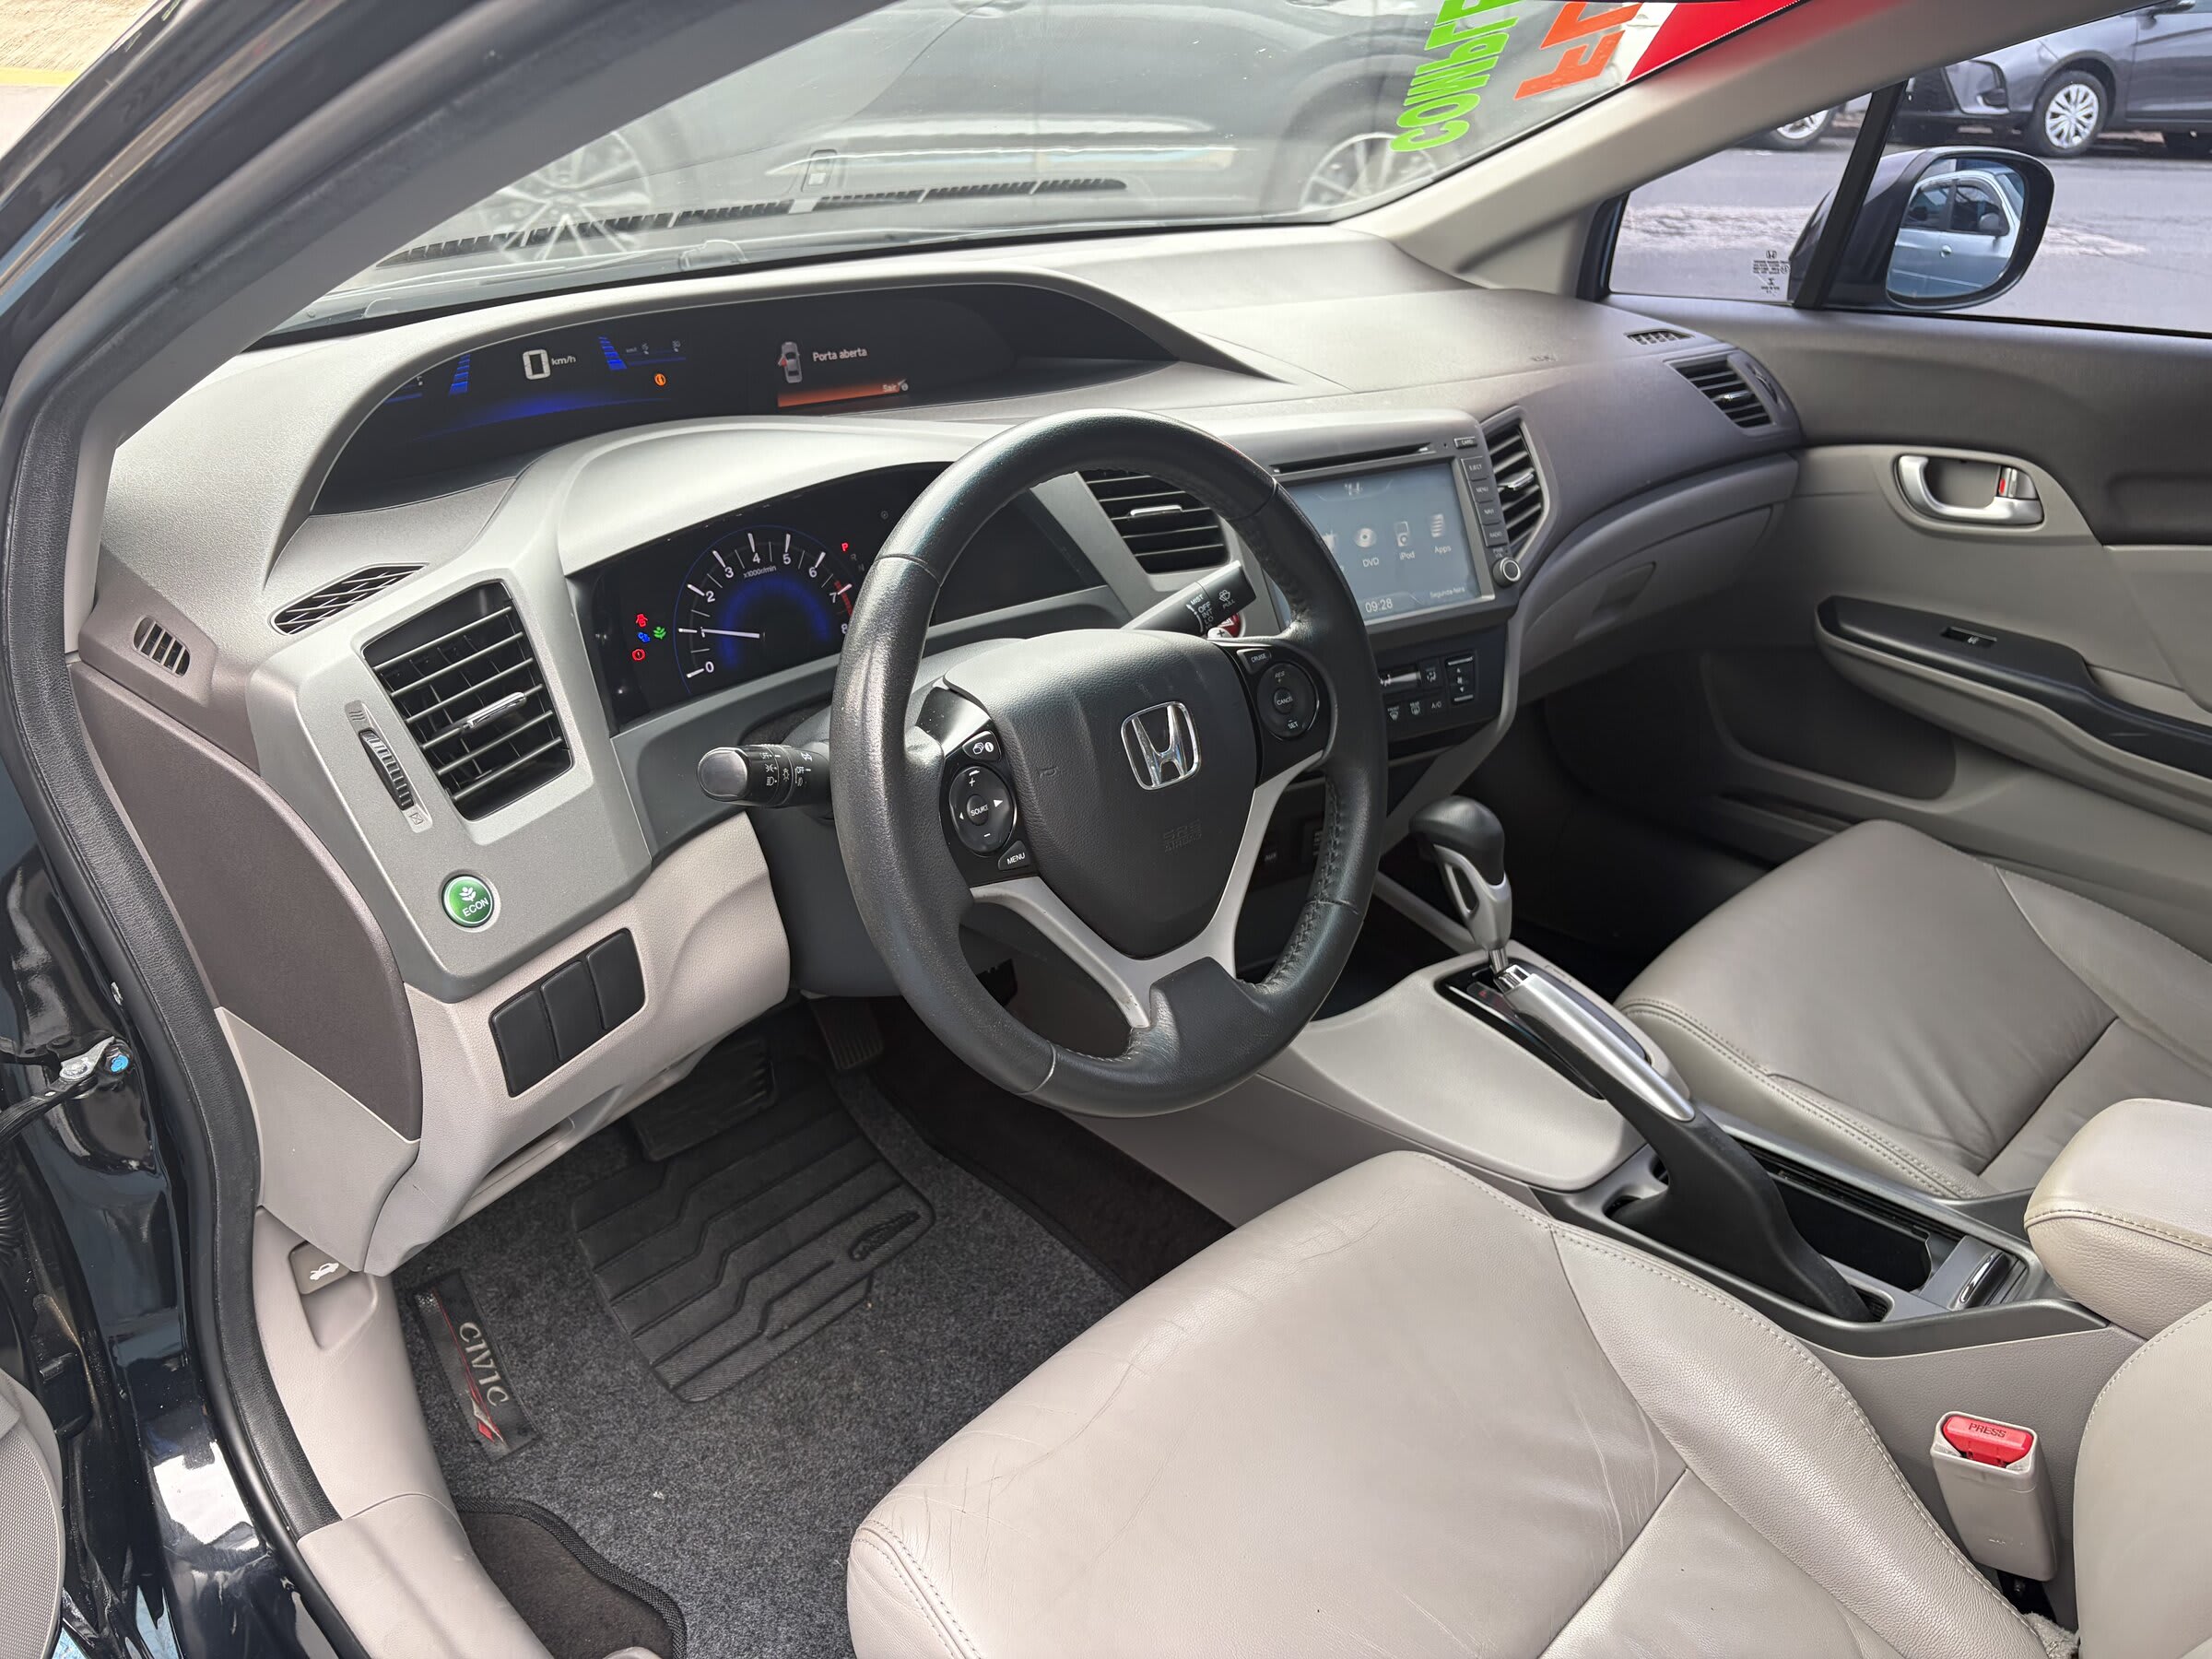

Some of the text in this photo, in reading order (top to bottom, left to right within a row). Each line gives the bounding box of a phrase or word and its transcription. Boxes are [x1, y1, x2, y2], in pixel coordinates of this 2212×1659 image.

[812, 347, 868, 362] Porta aberta
[523, 348, 577, 381] 0 km/h
[882, 383, 898, 393] Sair
[841, 542, 849, 552] P
[1434, 545, 1452, 555] Apps
[752, 553, 761, 564] 4
[782, 553, 792, 566] 5
[1399, 550, 1416, 560] iPod
[1362, 557, 1380, 568] DVD
[724, 566, 735, 579] 3
[808, 566, 818, 578] 6
[705, 590, 716, 603] 2
[829, 592, 837, 604] 7
[1190, 594, 1205, 606] MIST
[1197, 601, 1212, 614] OFF
[1365, 597, 1394, 614] 09:28
[841, 623, 848, 635] 8
[1251, 653, 1267, 664] CRUISE
[704, 661, 714, 673] 0
[1288, 721, 1299, 730] SET
[970, 804, 989, 818] SOURCE
[1006, 852, 1027, 865] MENU
[462, 897, 489, 918] ECON
[459, 1322, 509, 1406] CIVIC
[1968, 1422, 2007, 1438] PRESS
